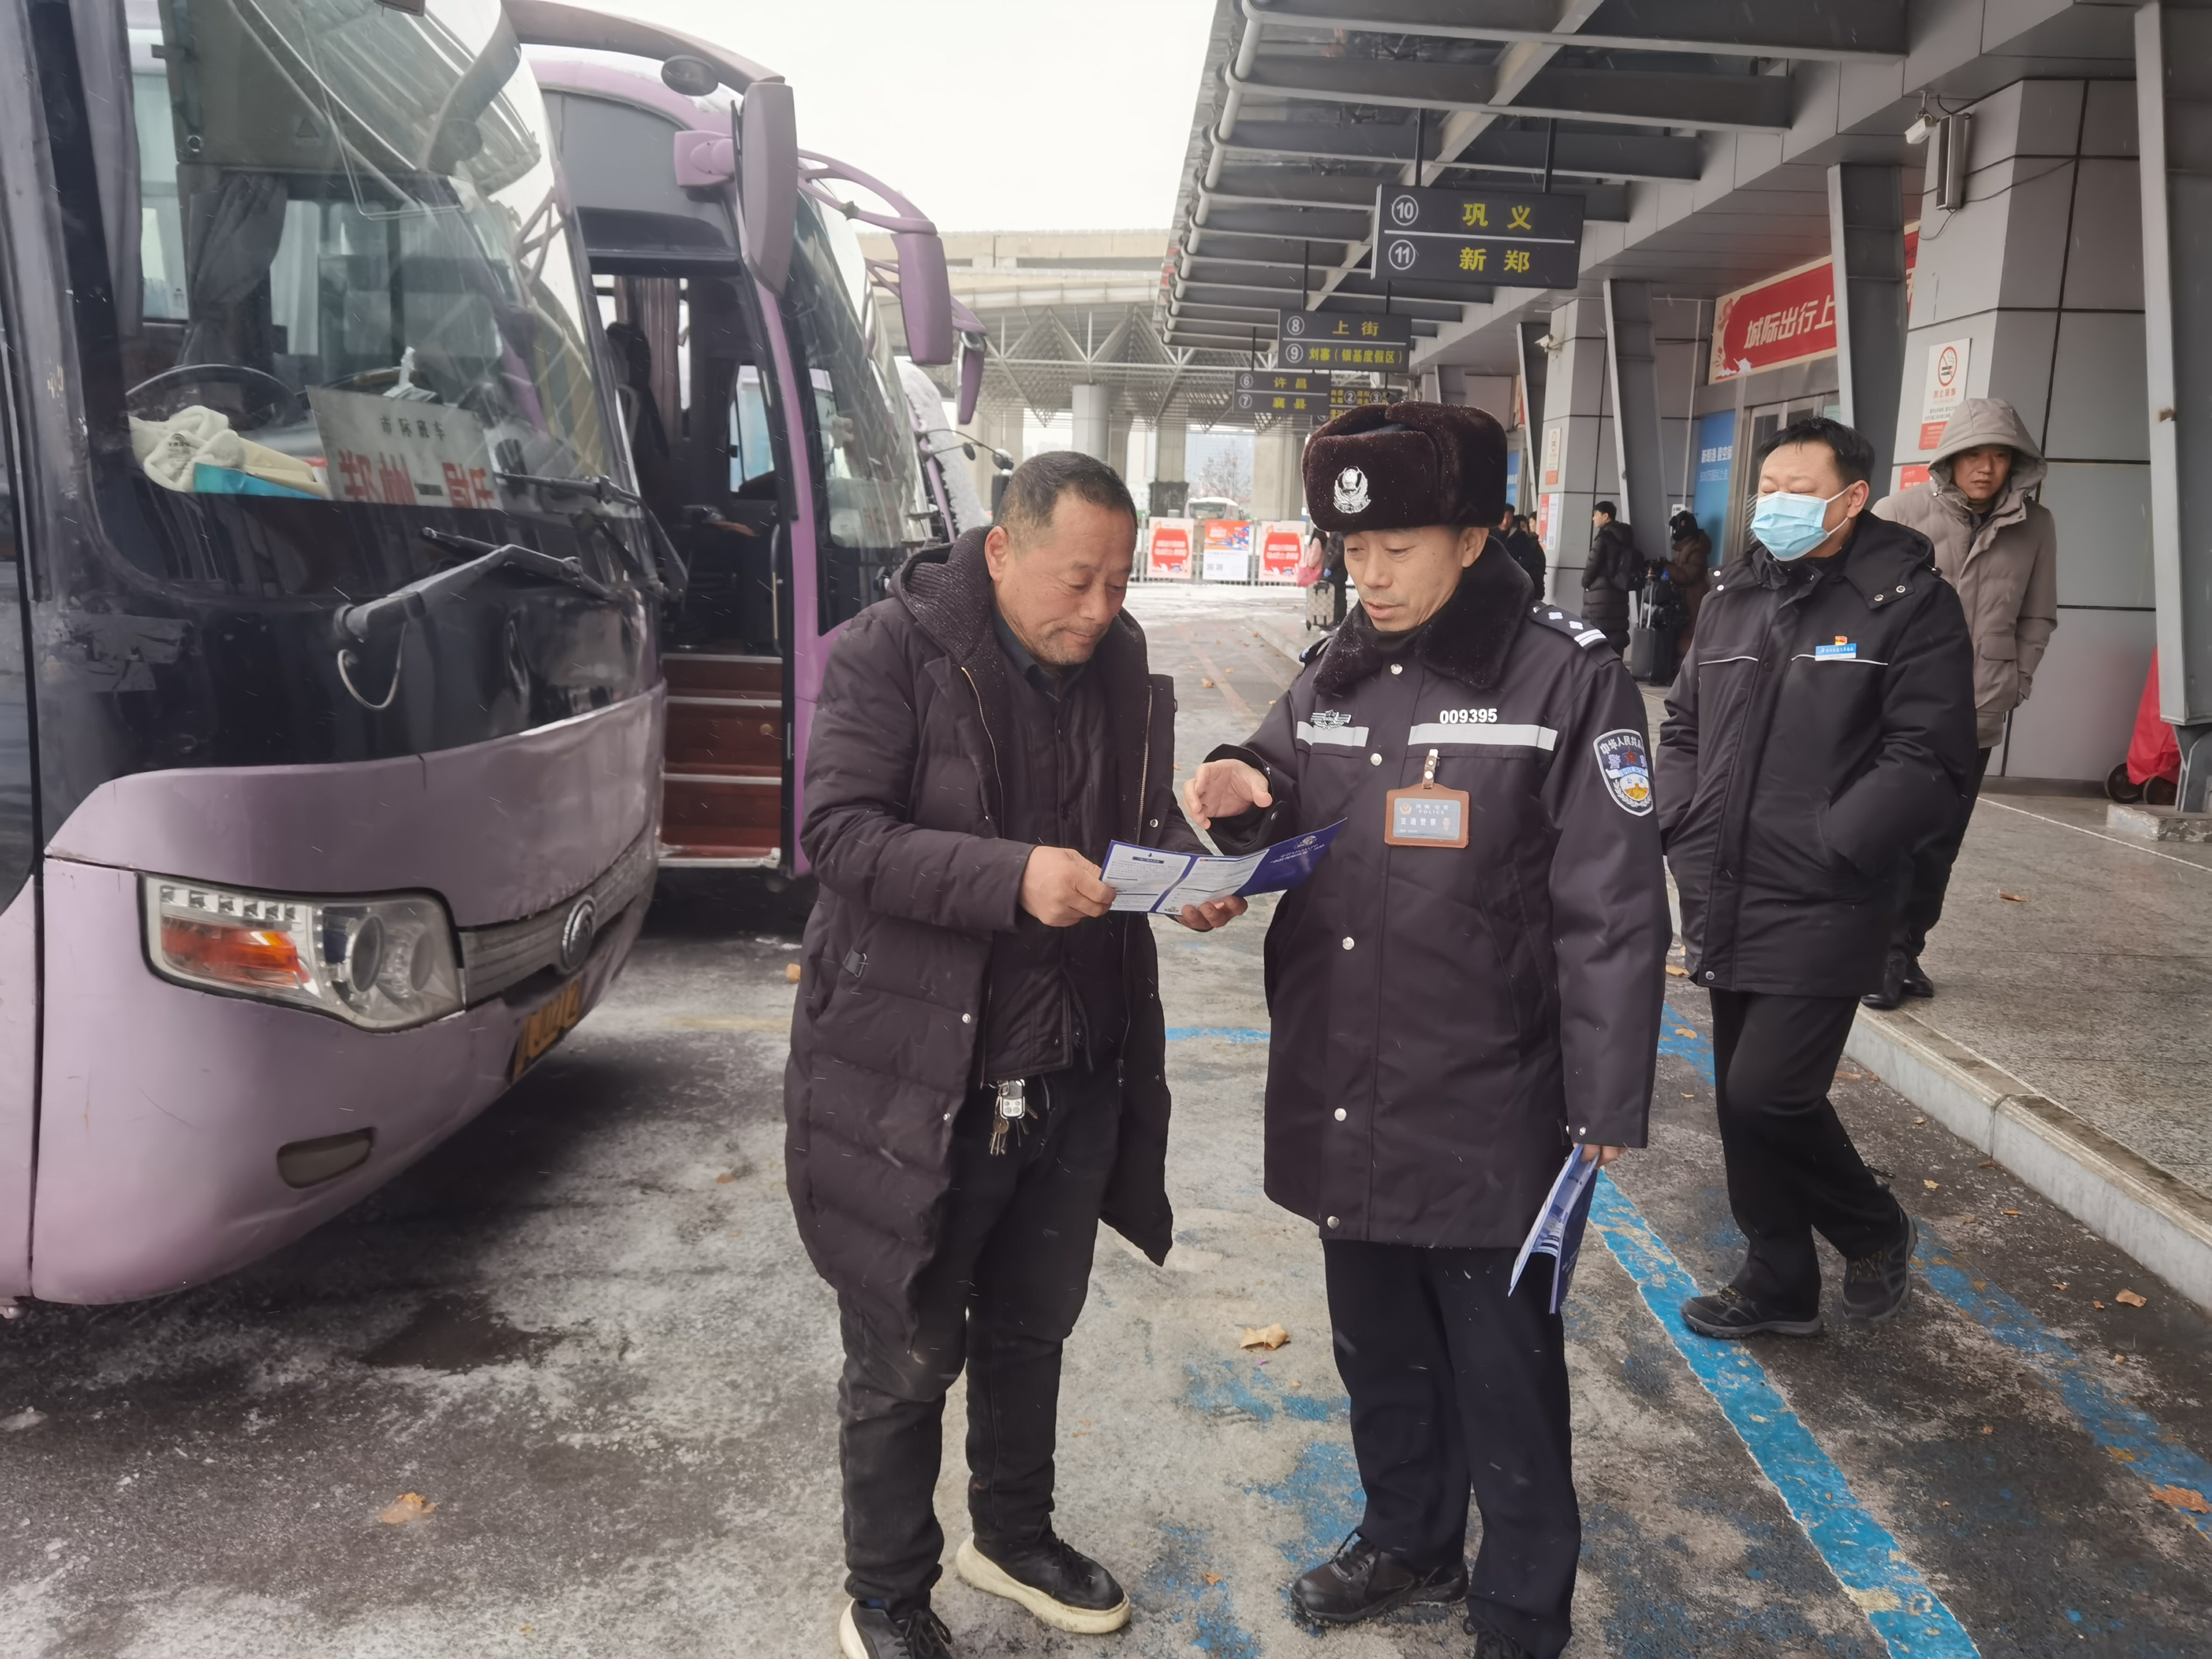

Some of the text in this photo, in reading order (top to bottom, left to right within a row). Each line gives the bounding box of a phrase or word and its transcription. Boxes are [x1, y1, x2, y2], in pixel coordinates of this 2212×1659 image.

[1397, 201, 1532, 230] 10 巩义
[1394, 245, 1530, 273] 11 新郑
[1332, 320, 1379, 336] 上街
[1744, 294, 1835, 349] 城际出行上
[1439, 708, 1498, 724] 009395
[1621, 767, 1644, 775] POLICE
[1400, 817, 1437, 826] 交通警察
